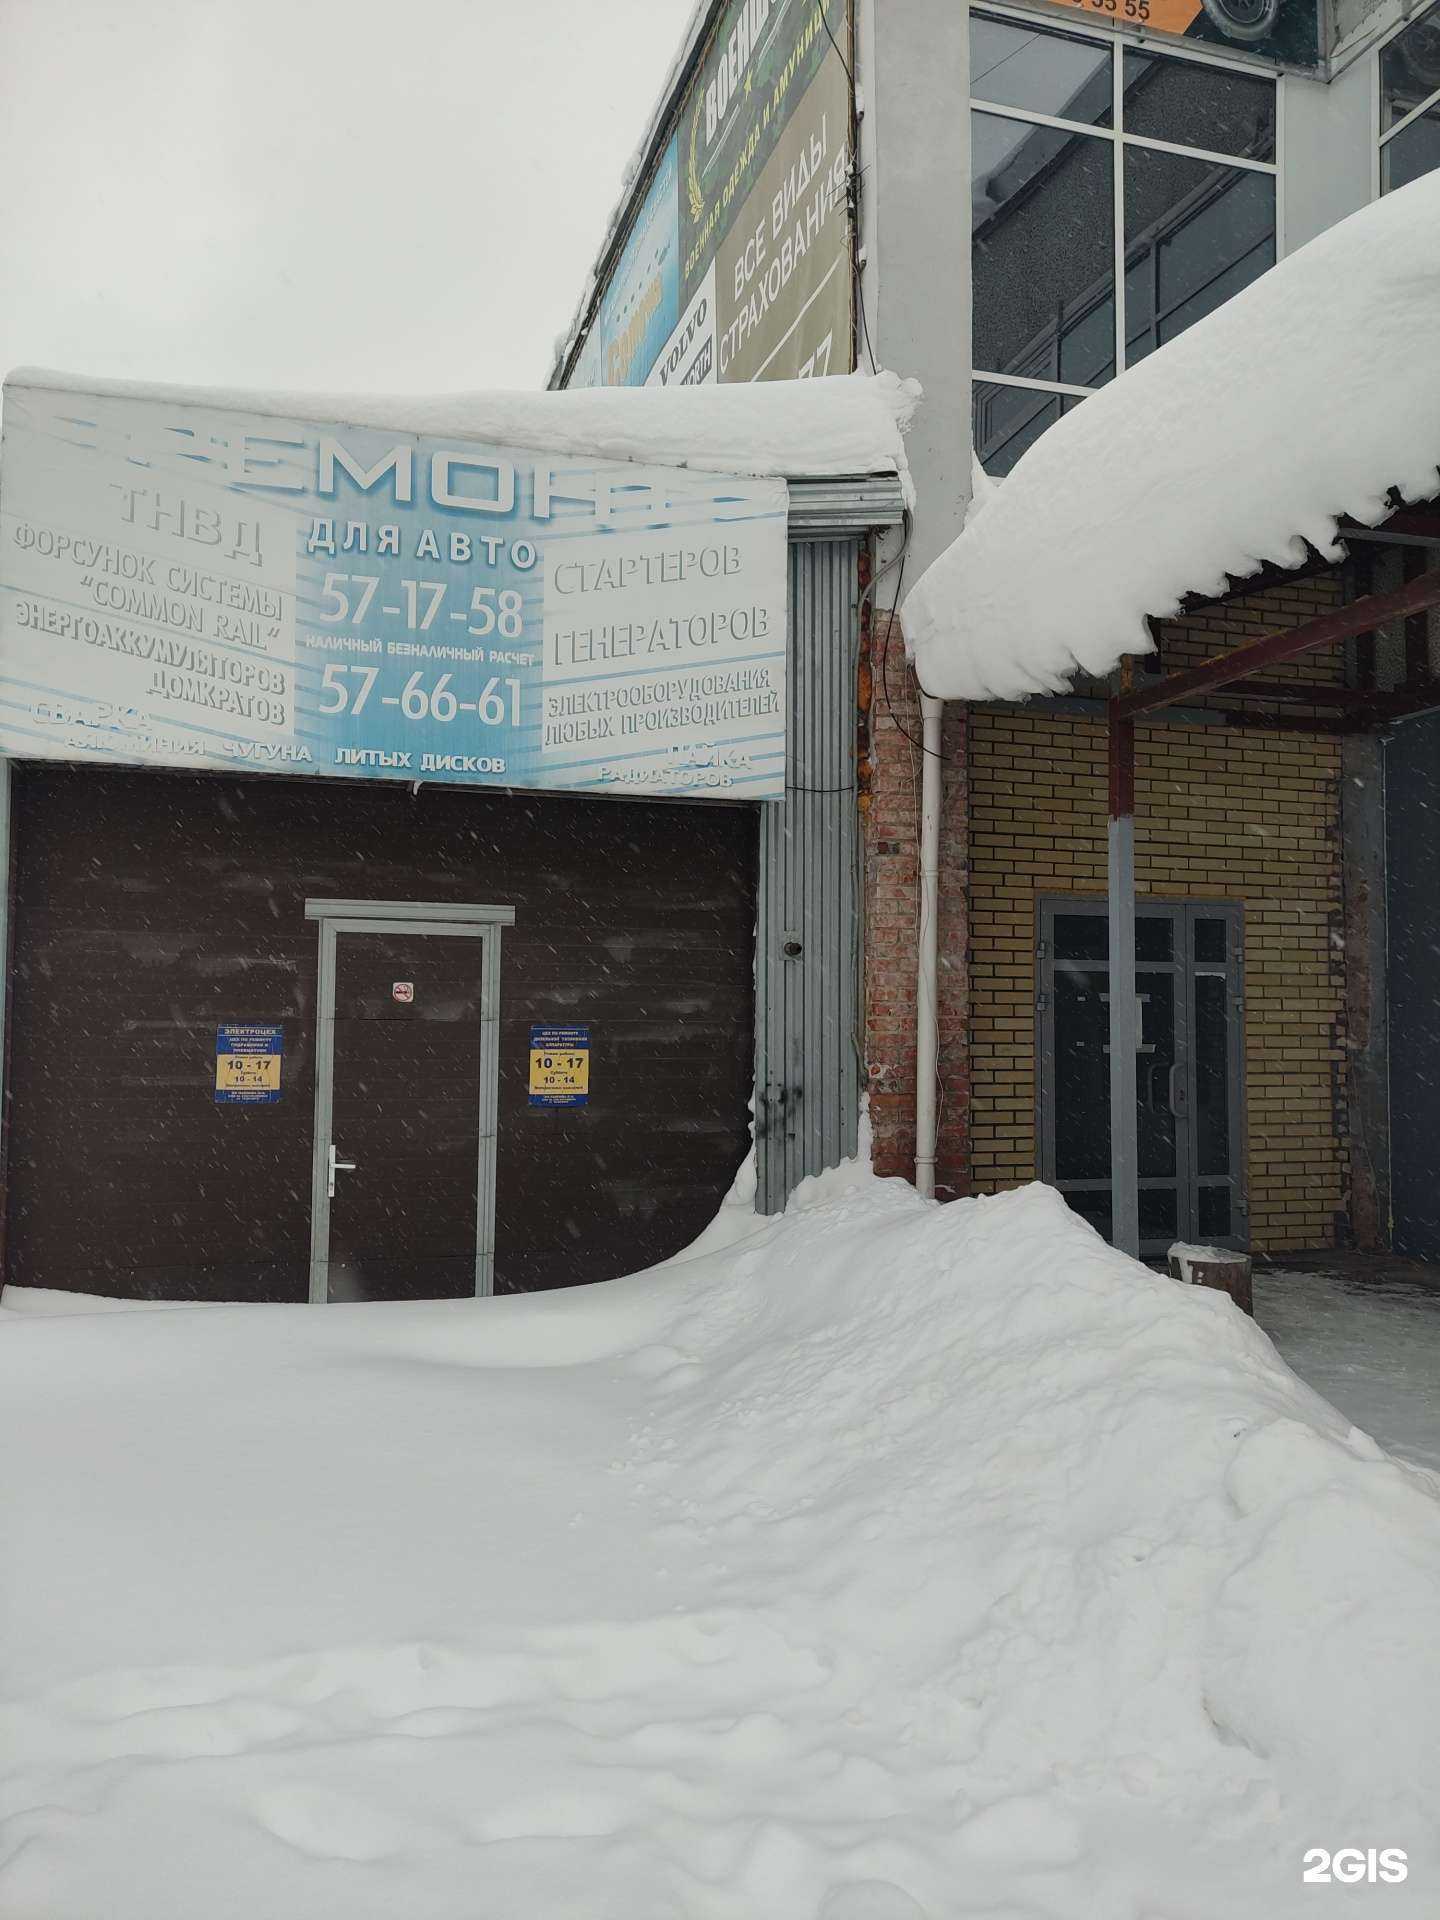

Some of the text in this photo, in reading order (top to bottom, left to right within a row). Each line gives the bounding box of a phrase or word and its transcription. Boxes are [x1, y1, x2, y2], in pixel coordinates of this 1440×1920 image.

[706, 0, 777, 147] ВОЕНШ
[723, 123, 760, 208] ОДЕЖДА
[734, 113, 827, 302] ВСЕ ВИДЫ
[720, 142, 847, 374] СТРАХОВАНИЯ
[660, 298, 707, 387] VOLVO
[108, 483, 263, 567] ТНВД
[307, 518, 537, 570] ДЛЯ АВТО
[13, 522, 282, 622] ФОРСУНОК СИСТЕМЫ
[554, 544, 743, 595] СТАРТЕРОВ
[318, 572, 524, 638] 57-17-58
[554, 605, 769, 666] ГЕНЕРАТОРОВ
[16, 601, 286, 697] ЭНЕРГОАККУМУЛЯТОРОВ
[305, 634, 536, 667] НАЛИЧНЫЙ БЕЗНАЛИЧНЫЙ РАСЧЕТ
[146, 670, 286, 727] ДОМКРАТОВ
[317, 663, 522, 727] 57-66-61
[544, 688, 781, 747] ЛЮБЫХ ПРОИЗВОДИТЕЛЕЙ
[548, 666, 771, 718] ЭЛЕКТРООБОРУДОВАНИЯ
[222, 741, 314, 764] ЧУГУНА
[334, 747, 412, 769] ЛИТЫХ
[420, 752, 507, 774] ДИСКОВ
